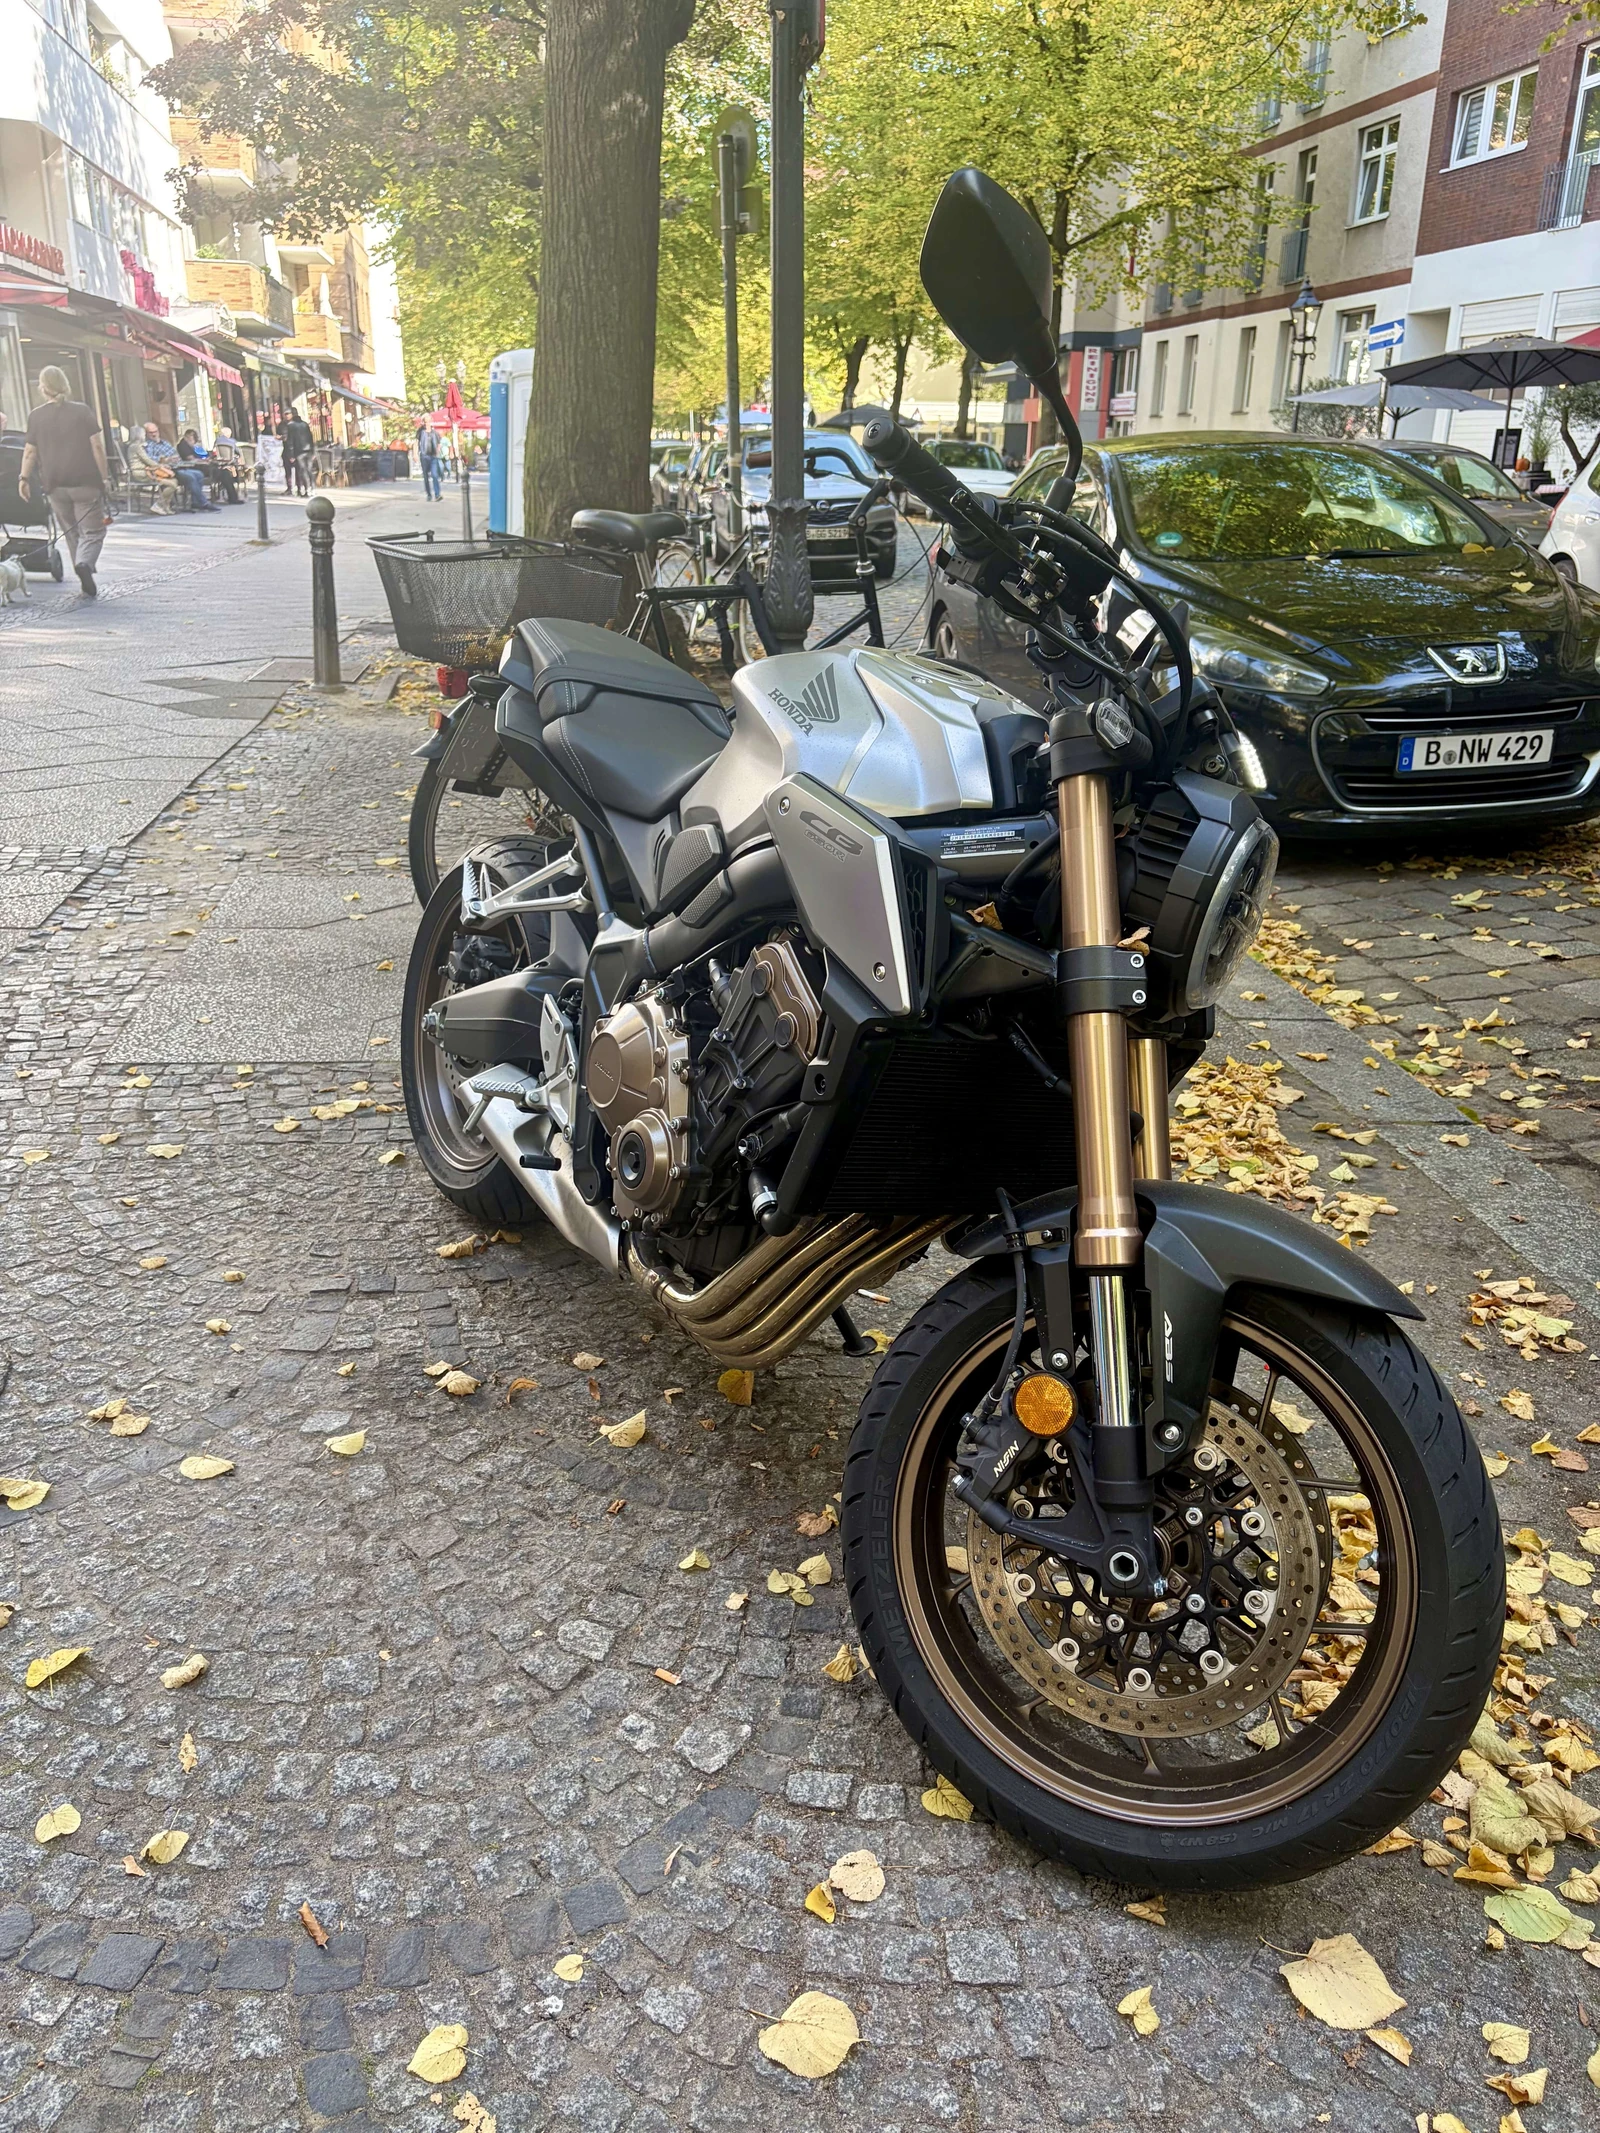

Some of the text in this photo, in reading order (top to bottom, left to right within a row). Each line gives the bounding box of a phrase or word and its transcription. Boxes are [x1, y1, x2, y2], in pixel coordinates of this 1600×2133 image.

[1085, 348, 1098, 403] REINIGUNG
[767, 687, 814, 737] HONDA
[1402, 735, 1543, 766] D B NW 429
[799, 810, 864, 857] CB
[804, 828, 846, 863] 650R
[1163, 1310, 1174, 1384] ABS
[871, 1474, 913, 1659] METZELER
[1359, 1693, 1416, 1776] 120/70
